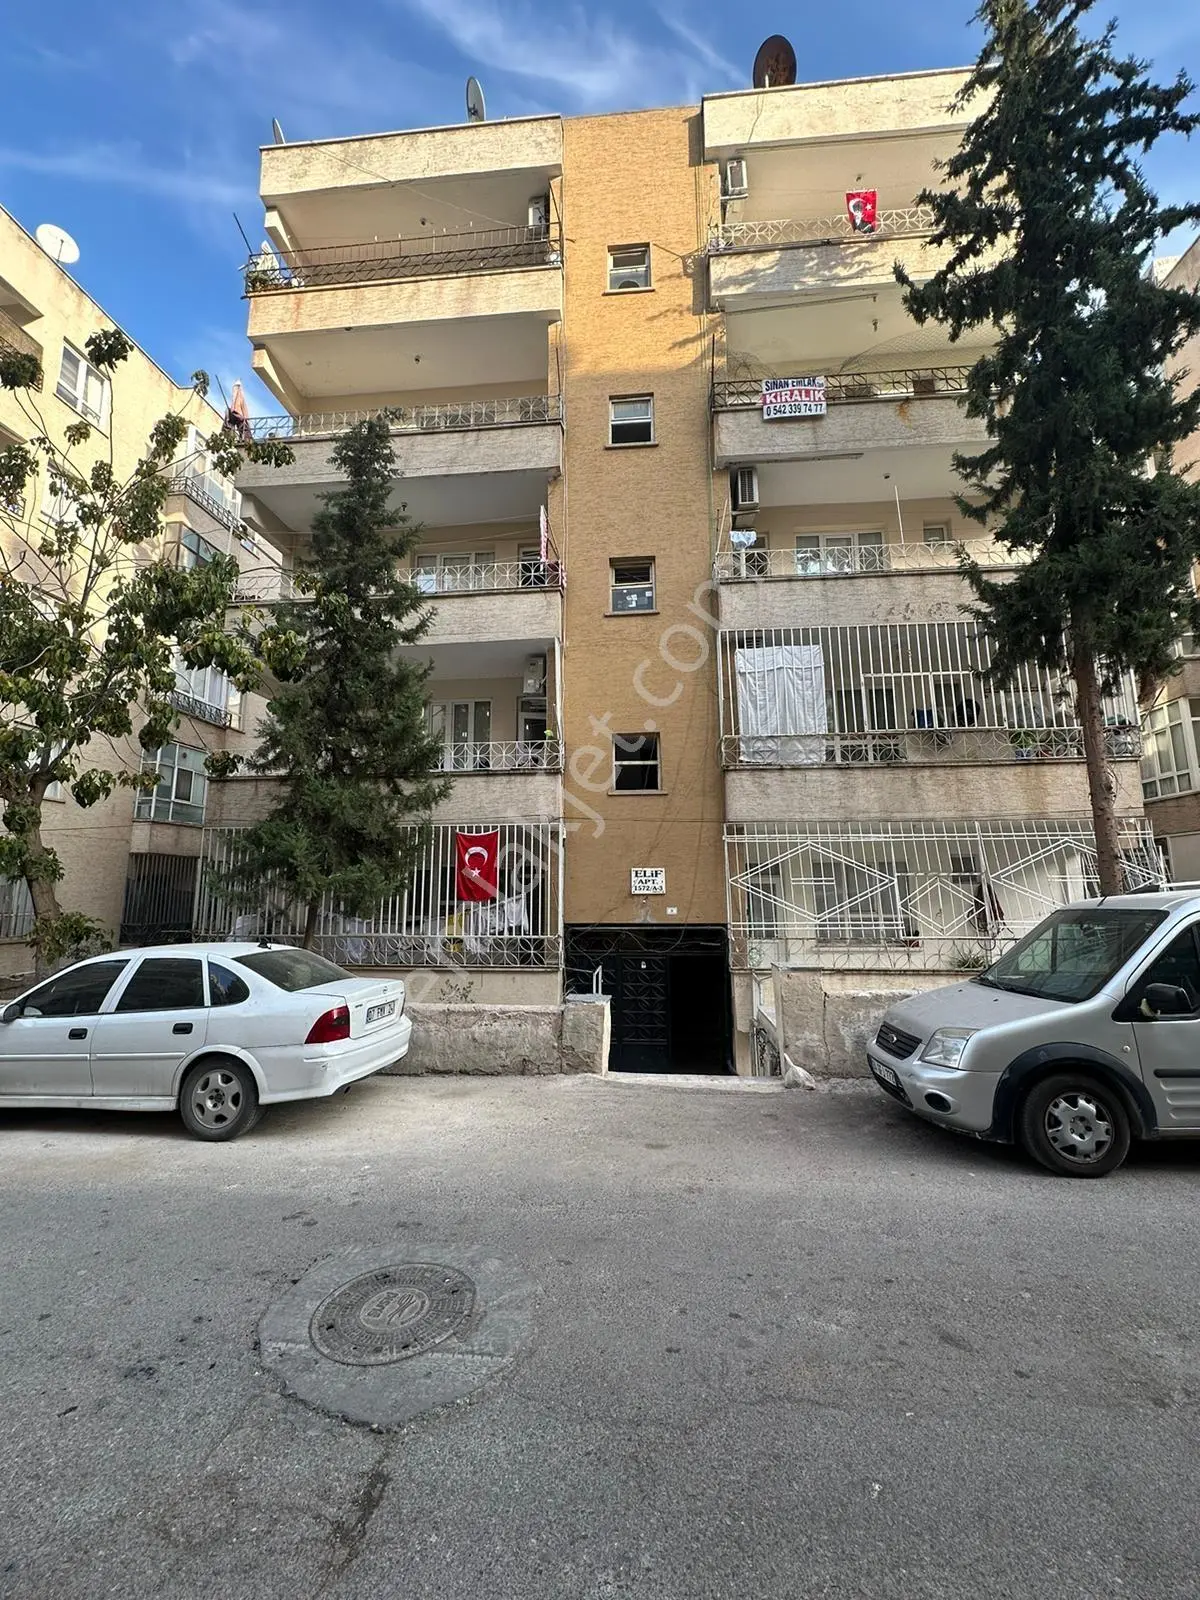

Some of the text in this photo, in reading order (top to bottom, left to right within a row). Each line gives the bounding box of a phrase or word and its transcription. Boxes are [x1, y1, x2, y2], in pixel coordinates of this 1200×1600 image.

[765, 390, 825, 403] KİRALIK
[766, 403, 823, 416] 0 542 339 74 77
